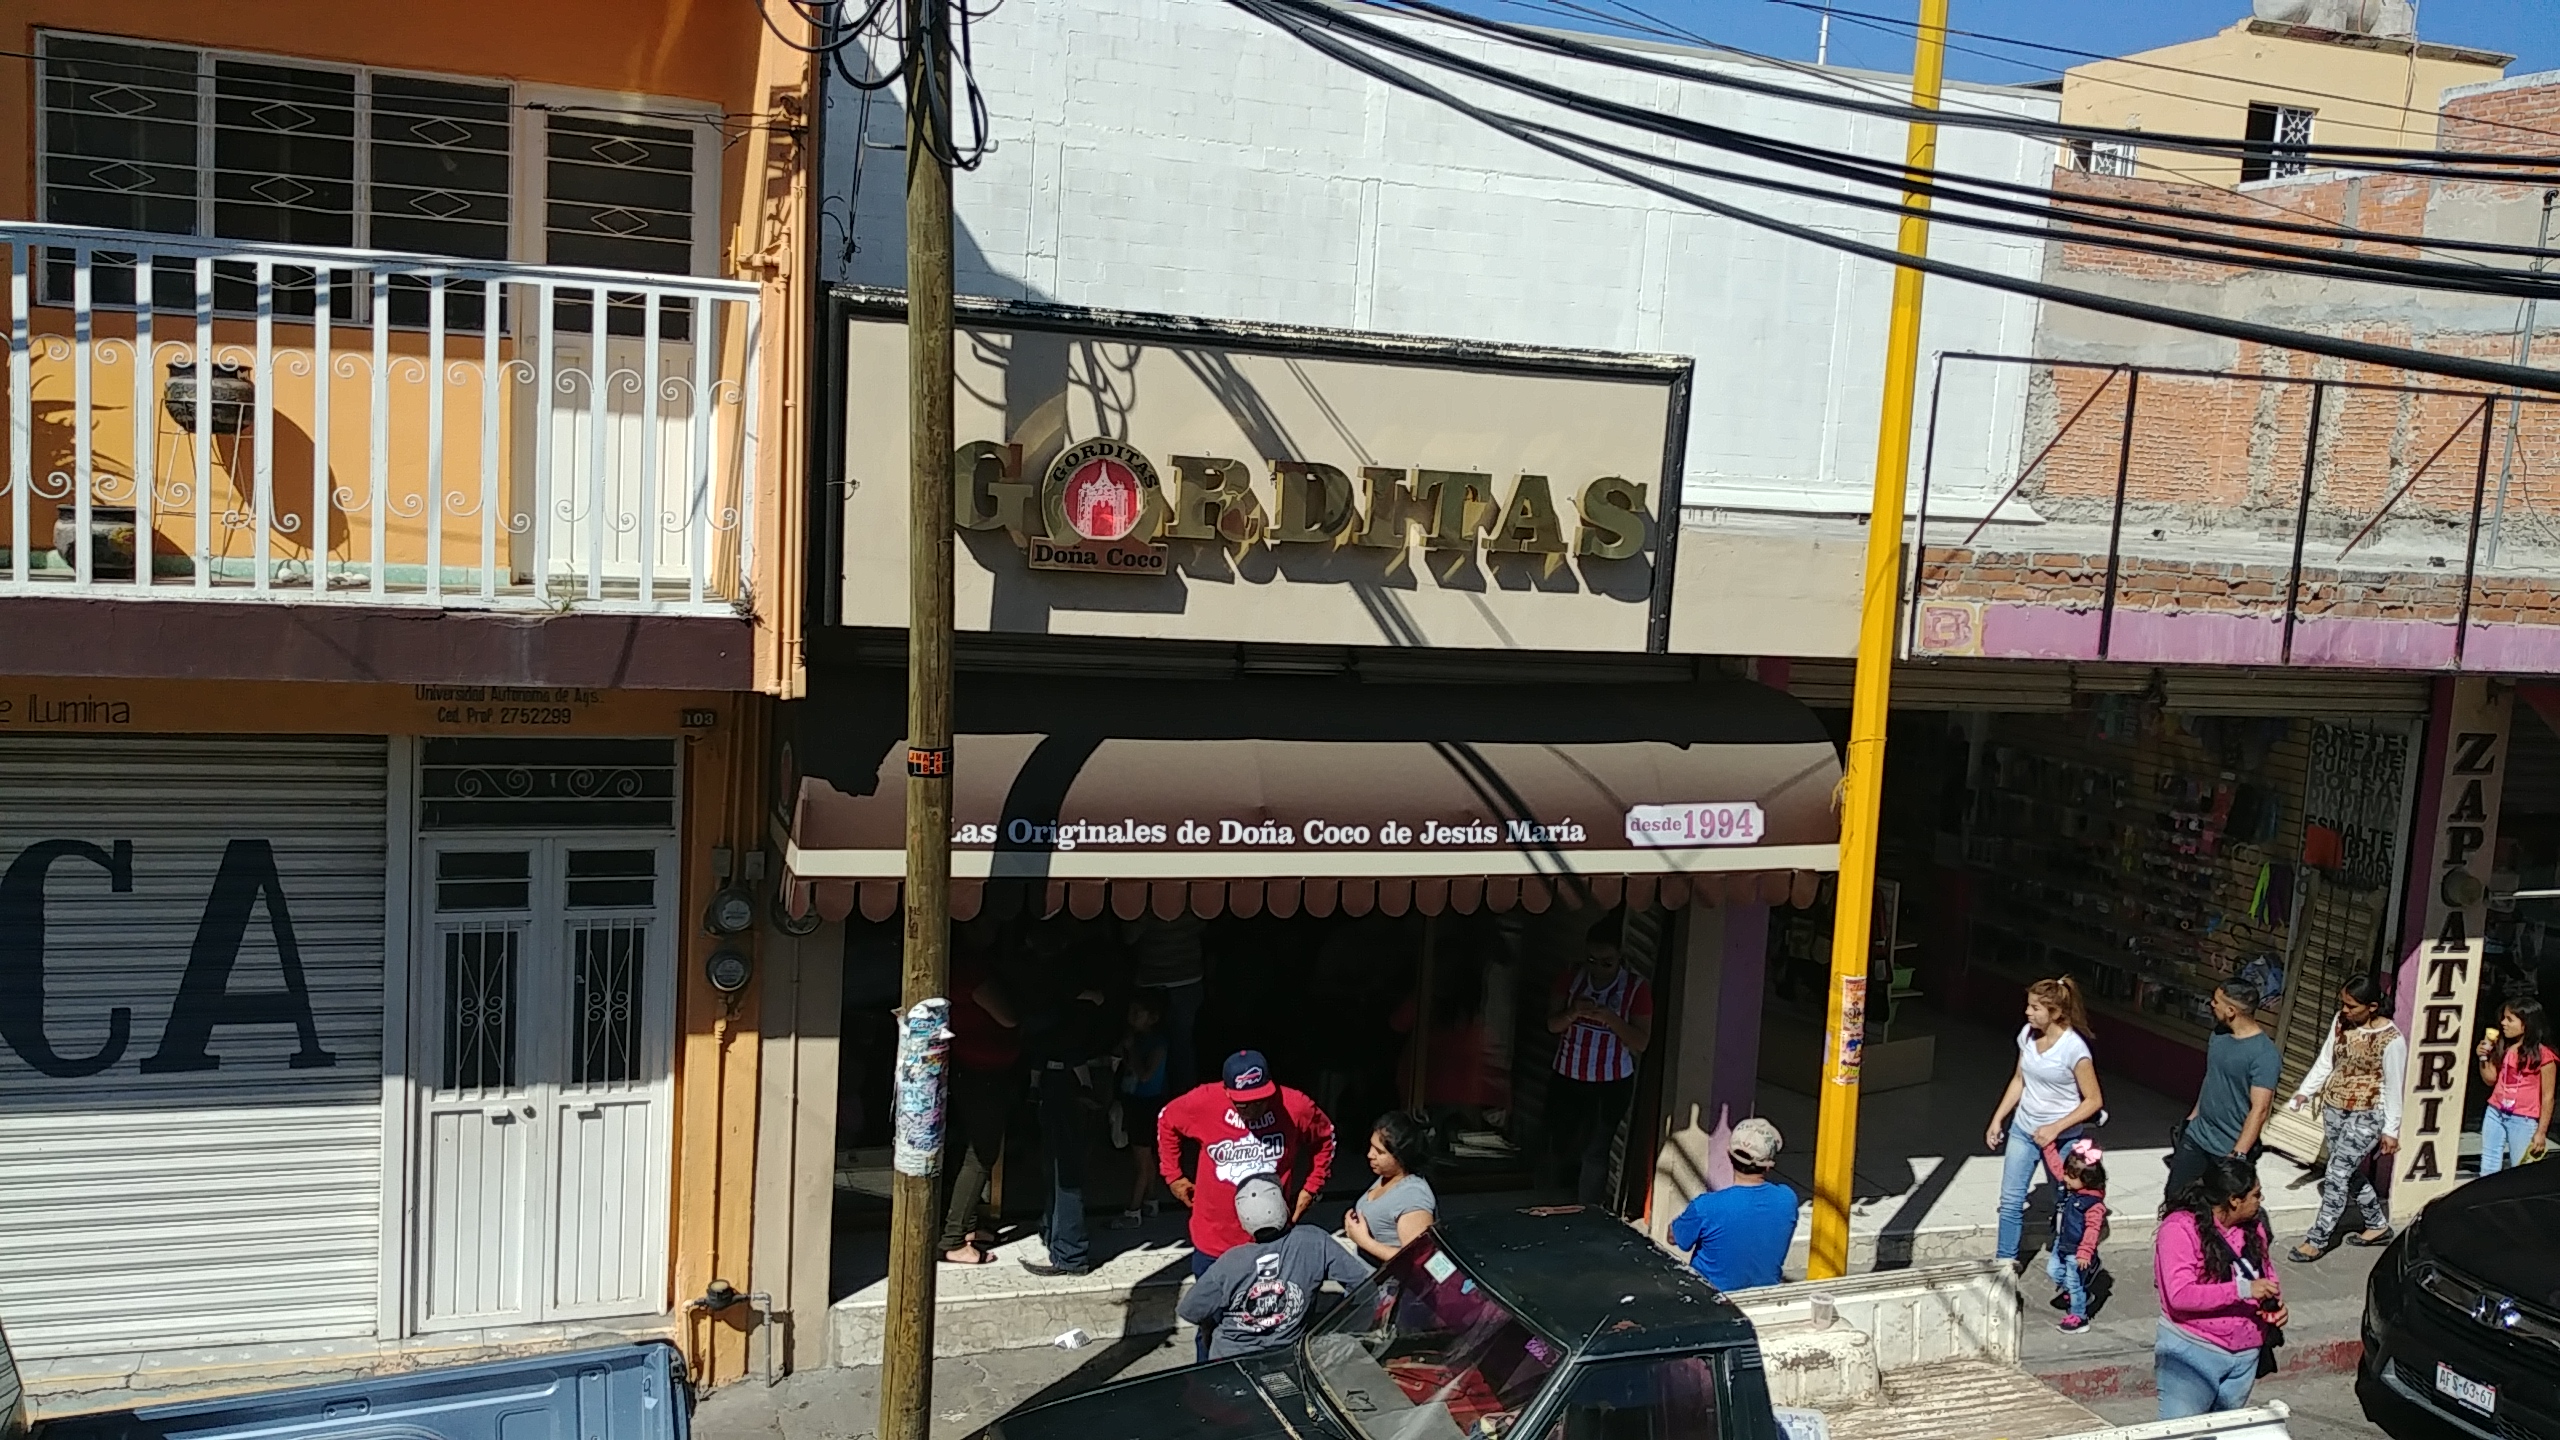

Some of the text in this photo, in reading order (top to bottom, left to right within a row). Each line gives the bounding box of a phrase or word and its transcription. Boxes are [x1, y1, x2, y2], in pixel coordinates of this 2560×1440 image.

[1053, 443, 1159, 489] GORDITAS
[1034, 543, 1163, 569] Doña Coco
[415, 684, 485, 702] Universidad
[554, 688, 569, 703] de
[500, 707, 572, 725] 2752299
[684, 712, 715, 726] 103
[1007, 818, 1168, 851] Originales
[1176, 819, 1211, 845] de
[1218, 817, 1296, 845] Doña
[1302, 820, 1371, 846] Coco
[1379, 819, 1412, 846] de
[1418, 817, 1498, 846] Jesús
[1504, 816, 1587, 844] María
[1629, 808, 1754, 840] desde 1994
[2304, 814, 2395, 850] ESMALTE
[0, 838, 337, 1078] CA
[1248, 1110, 1276, 1130] CLUB
[2439, 1369, 2493, 1407] AFS-63-67
